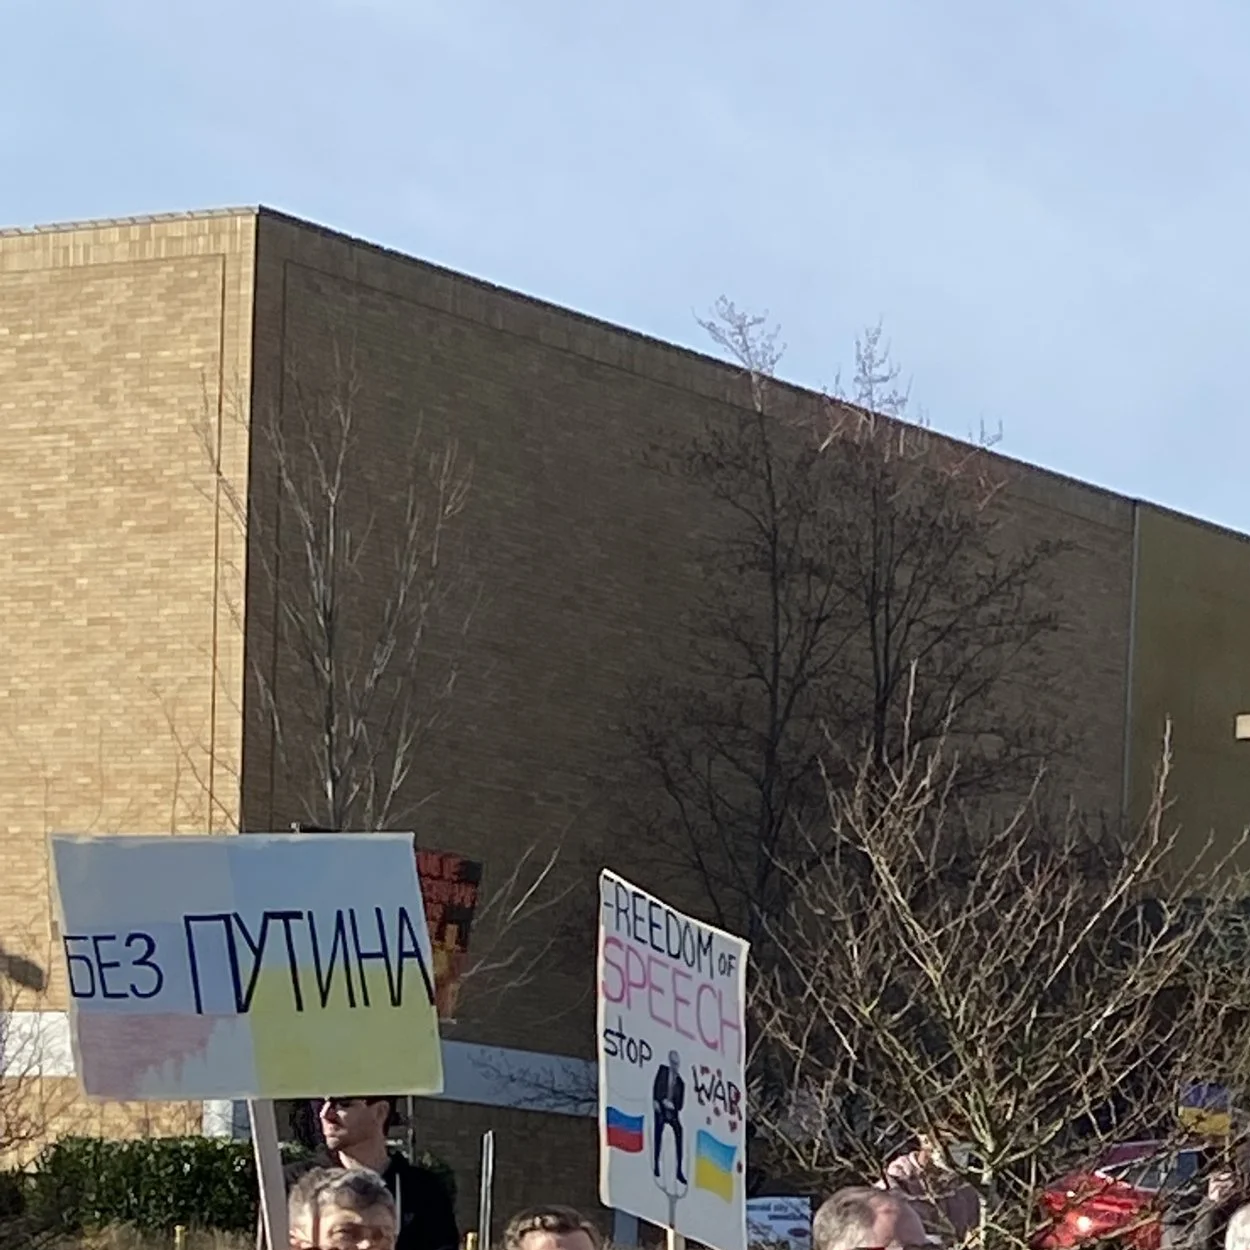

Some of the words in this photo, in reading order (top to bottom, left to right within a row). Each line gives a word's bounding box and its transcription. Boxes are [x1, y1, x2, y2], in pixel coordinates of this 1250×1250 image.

[62, 931, 164, 999] БЕЗ
[183, 906, 435, 1015] ПУТИНА
[601, 935, 742, 1063] SPEECH
[691, 1063, 742, 1122] WAR
